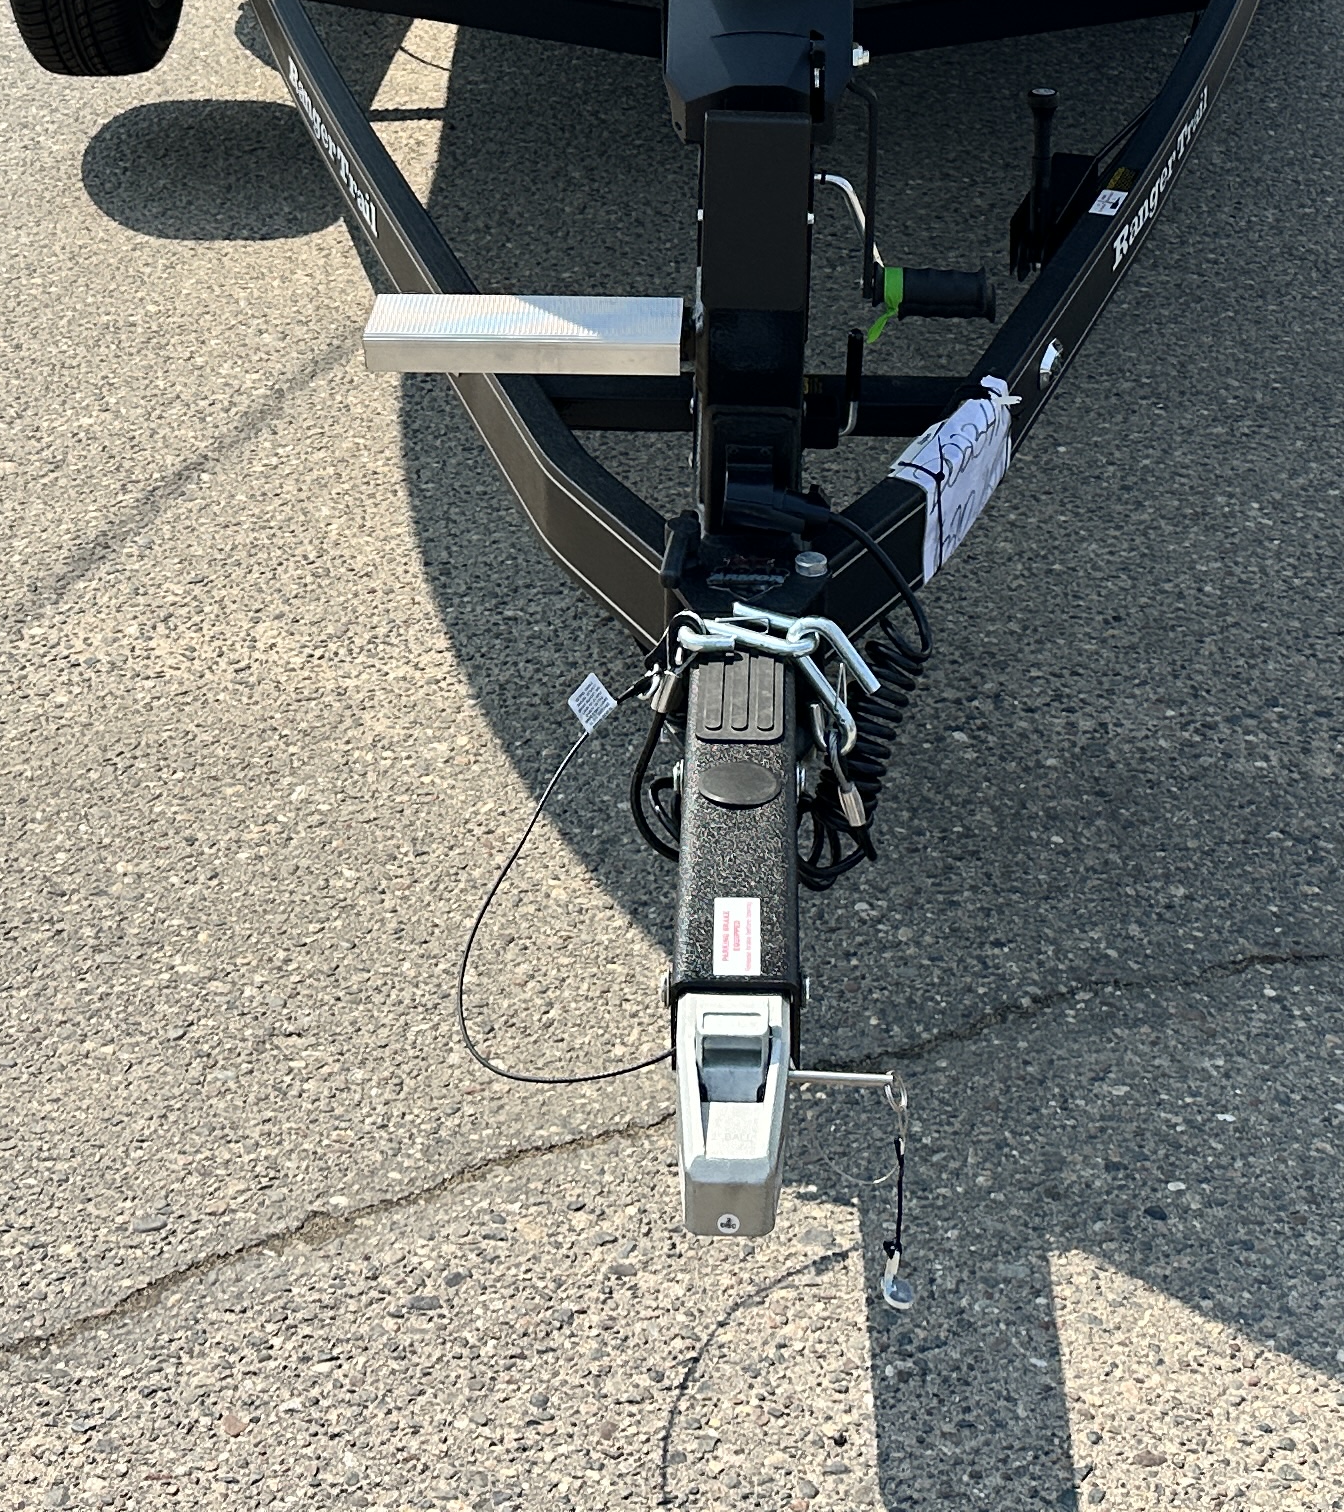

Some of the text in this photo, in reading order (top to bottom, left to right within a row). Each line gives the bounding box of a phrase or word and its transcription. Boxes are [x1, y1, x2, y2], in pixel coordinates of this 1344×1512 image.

[288, 55, 379, 238] Ranger Trail
[1112, 149, 1176, 272] Ranger
[1176, 85, 1208, 160] Trail
